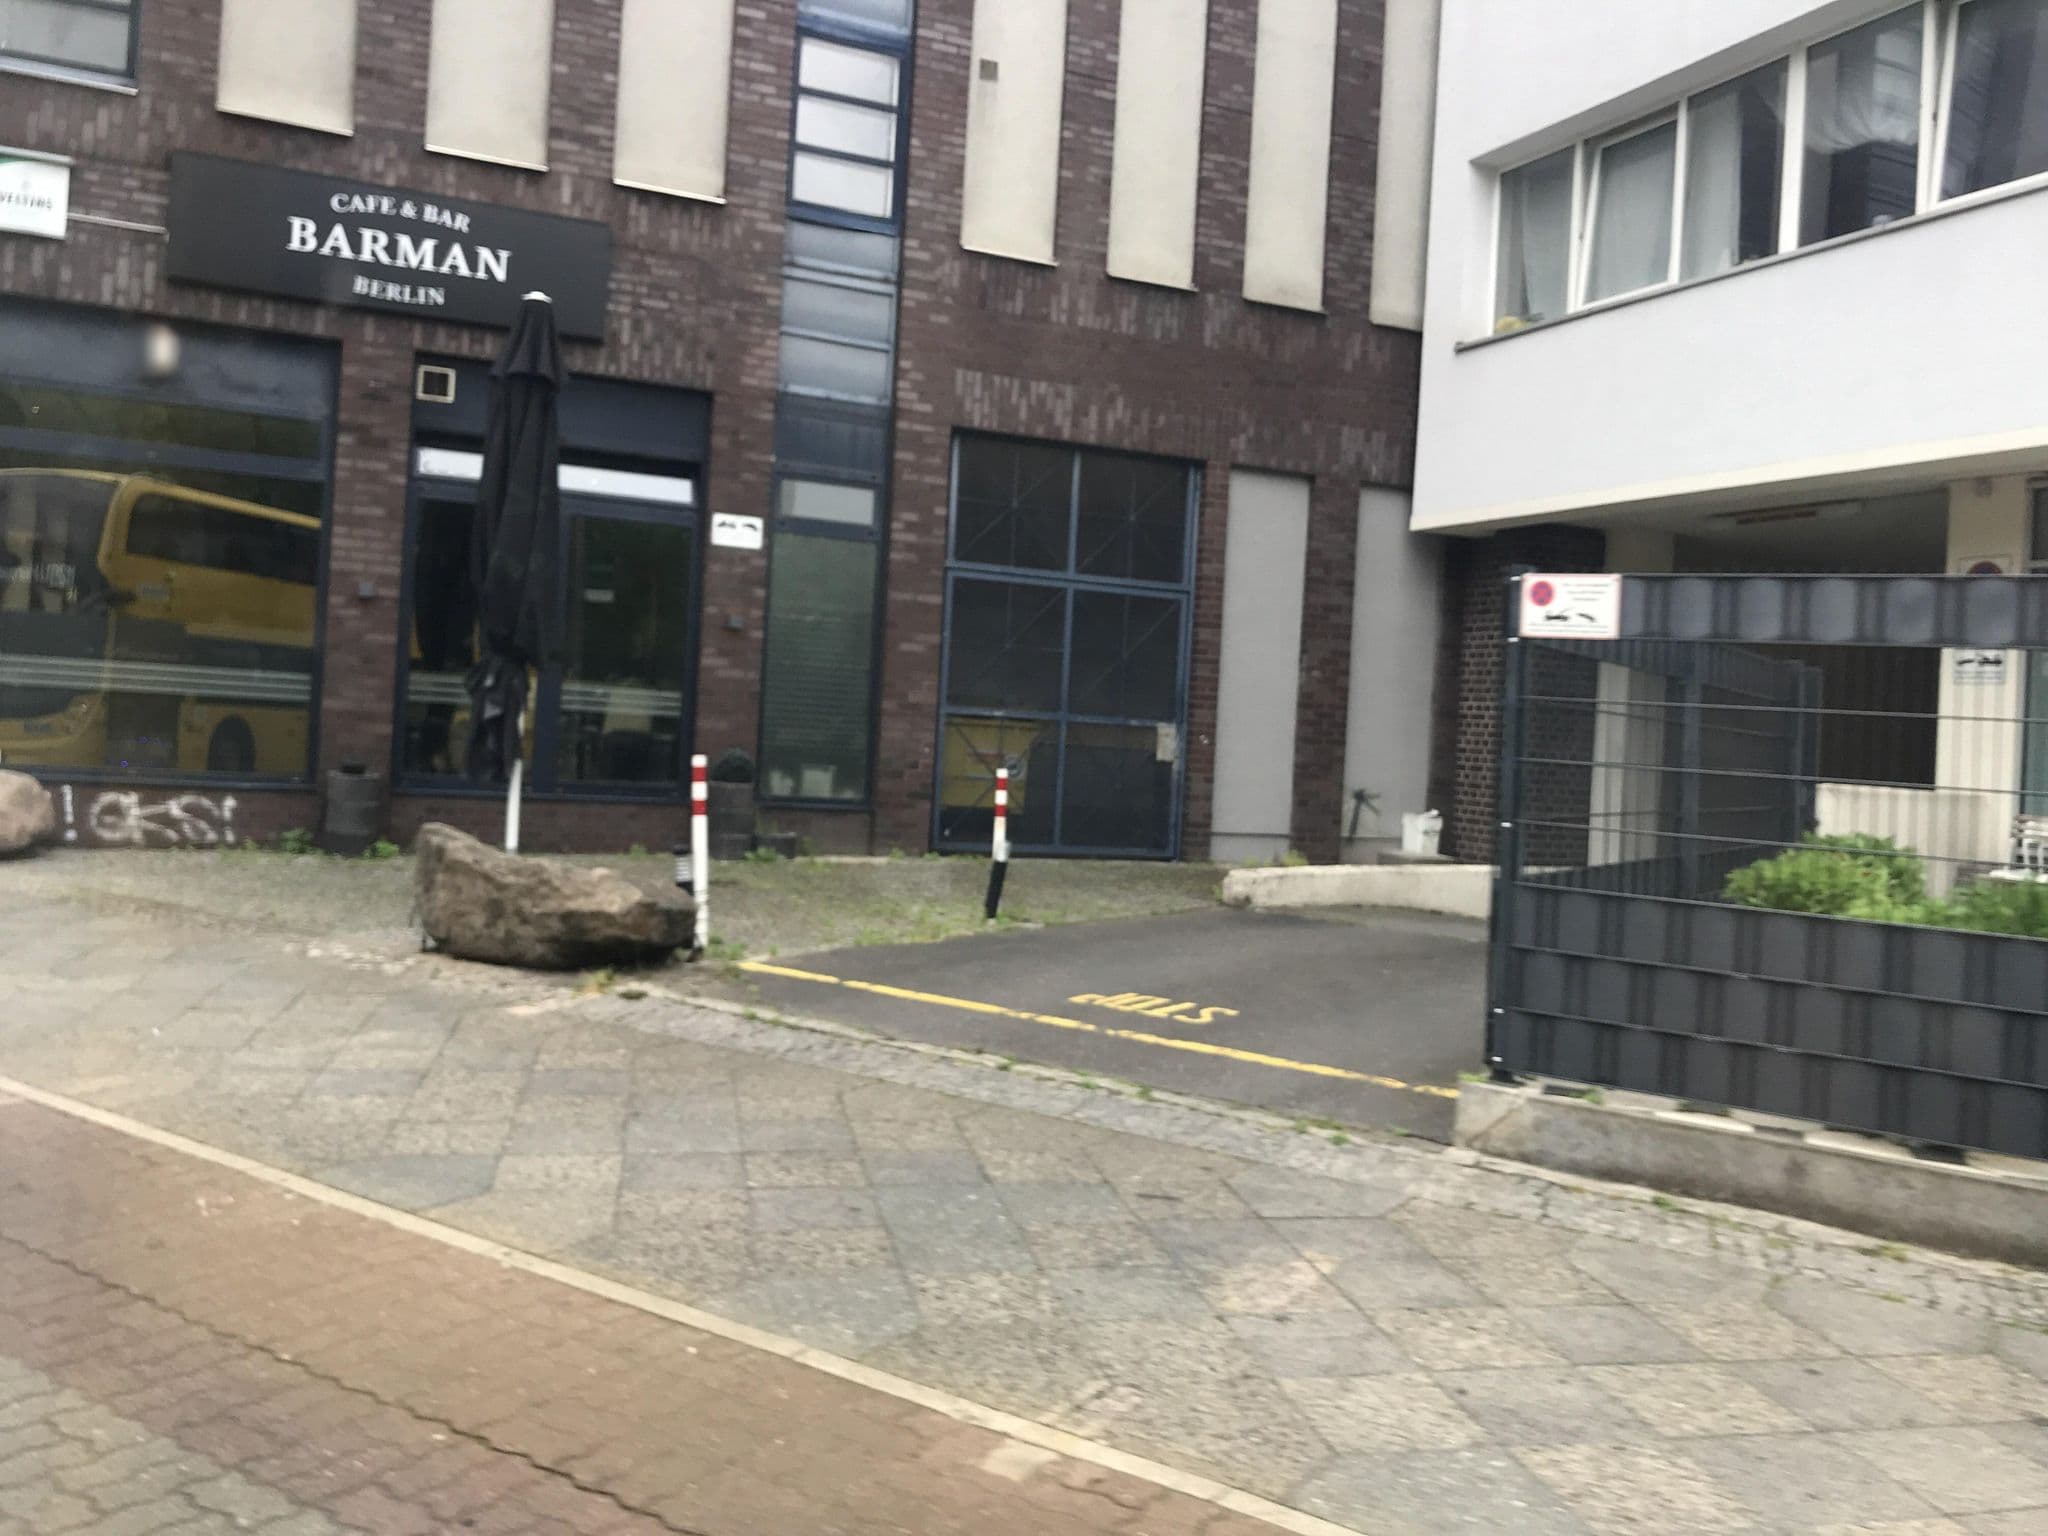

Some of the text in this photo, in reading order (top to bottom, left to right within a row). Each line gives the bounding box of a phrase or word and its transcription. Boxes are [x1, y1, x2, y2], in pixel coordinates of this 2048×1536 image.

[329, 192, 471, 235] CAFE & BAR
[285, 215, 512, 283] BARMAN
[352, 274, 446, 307] BERLIN
[1067, 992, 1241, 1025] STOP
